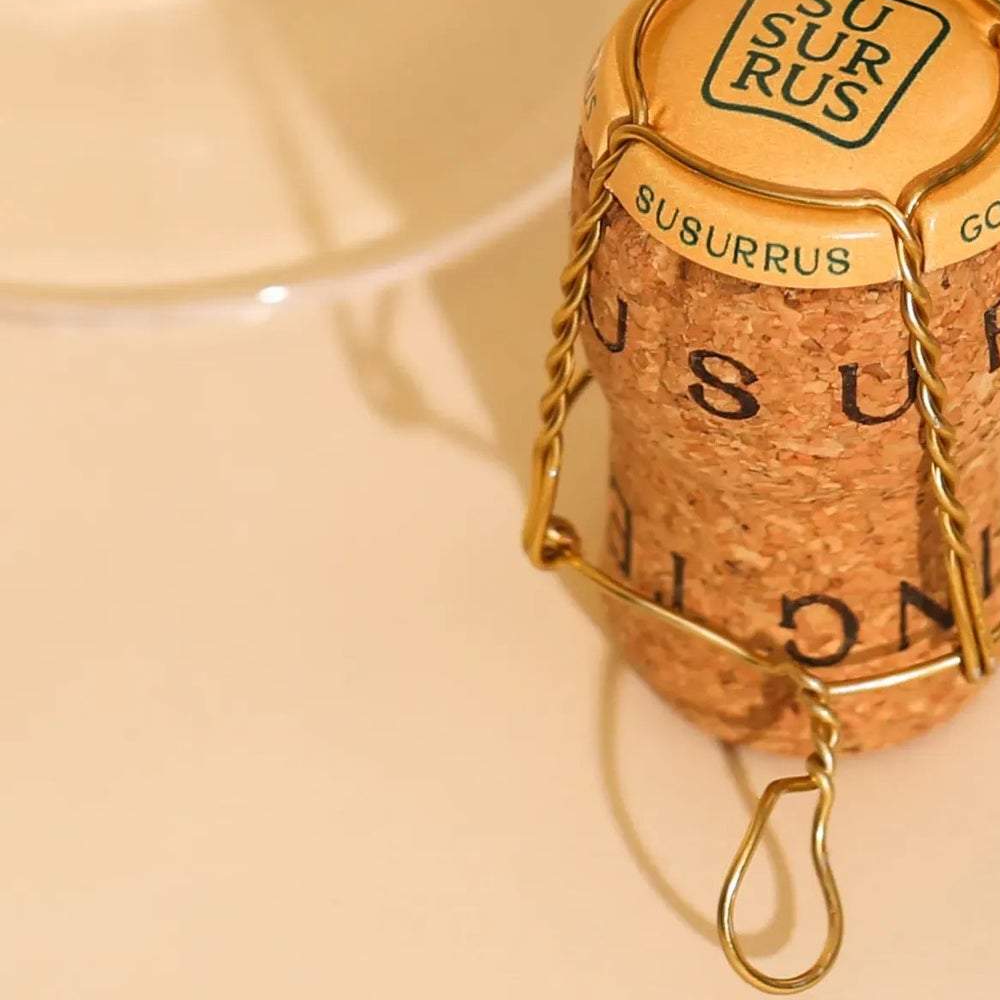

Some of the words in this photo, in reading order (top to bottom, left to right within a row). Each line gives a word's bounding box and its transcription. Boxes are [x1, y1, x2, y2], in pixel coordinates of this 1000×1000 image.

[751, 11, 893, 86] SUR
[730, 50, 868, 123] RUS
[635, 183, 851, 276] SUSURRUS
